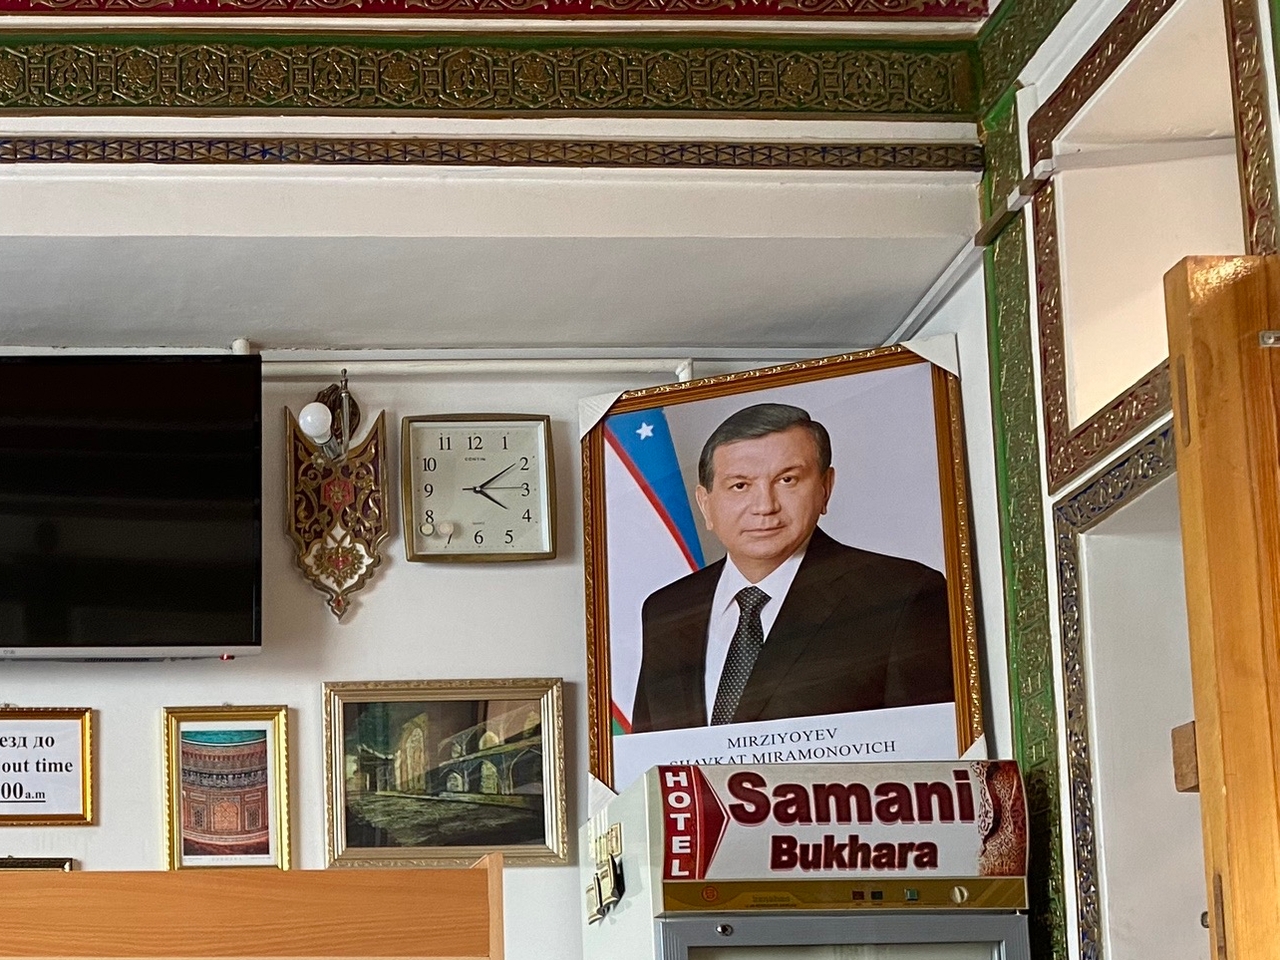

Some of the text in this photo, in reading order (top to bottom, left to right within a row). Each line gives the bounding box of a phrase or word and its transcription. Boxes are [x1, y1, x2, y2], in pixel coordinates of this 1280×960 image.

[439, 436, 452, 450] 11
[468, 436, 483, 450] 12
[502, 436, 508, 450] 1
[422, 457, 436, 472] 10
[520, 456, 529, 471] 2
[424, 483, 433, 498] 9
[522, 482, 530, 497] 3
[425, 510, 434, 524] 8
[522, 509, 532, 522] 4
[474, 530, 484, 544] 6
[505, 530, 514, 544] 5
[33, 736, 55, 749] до
[728, 728, 838, 749] MIRZIYOYEV
[752, 741, 896, 764] MIRAMONOVICH
[2, 759, 30, 773] out
[35, 758, 73, 773] time
[727, 769, 976, 826] Samani
[665, 771, 692, 877] HOTEL
[770, 835, 939, 871] Bukhara
